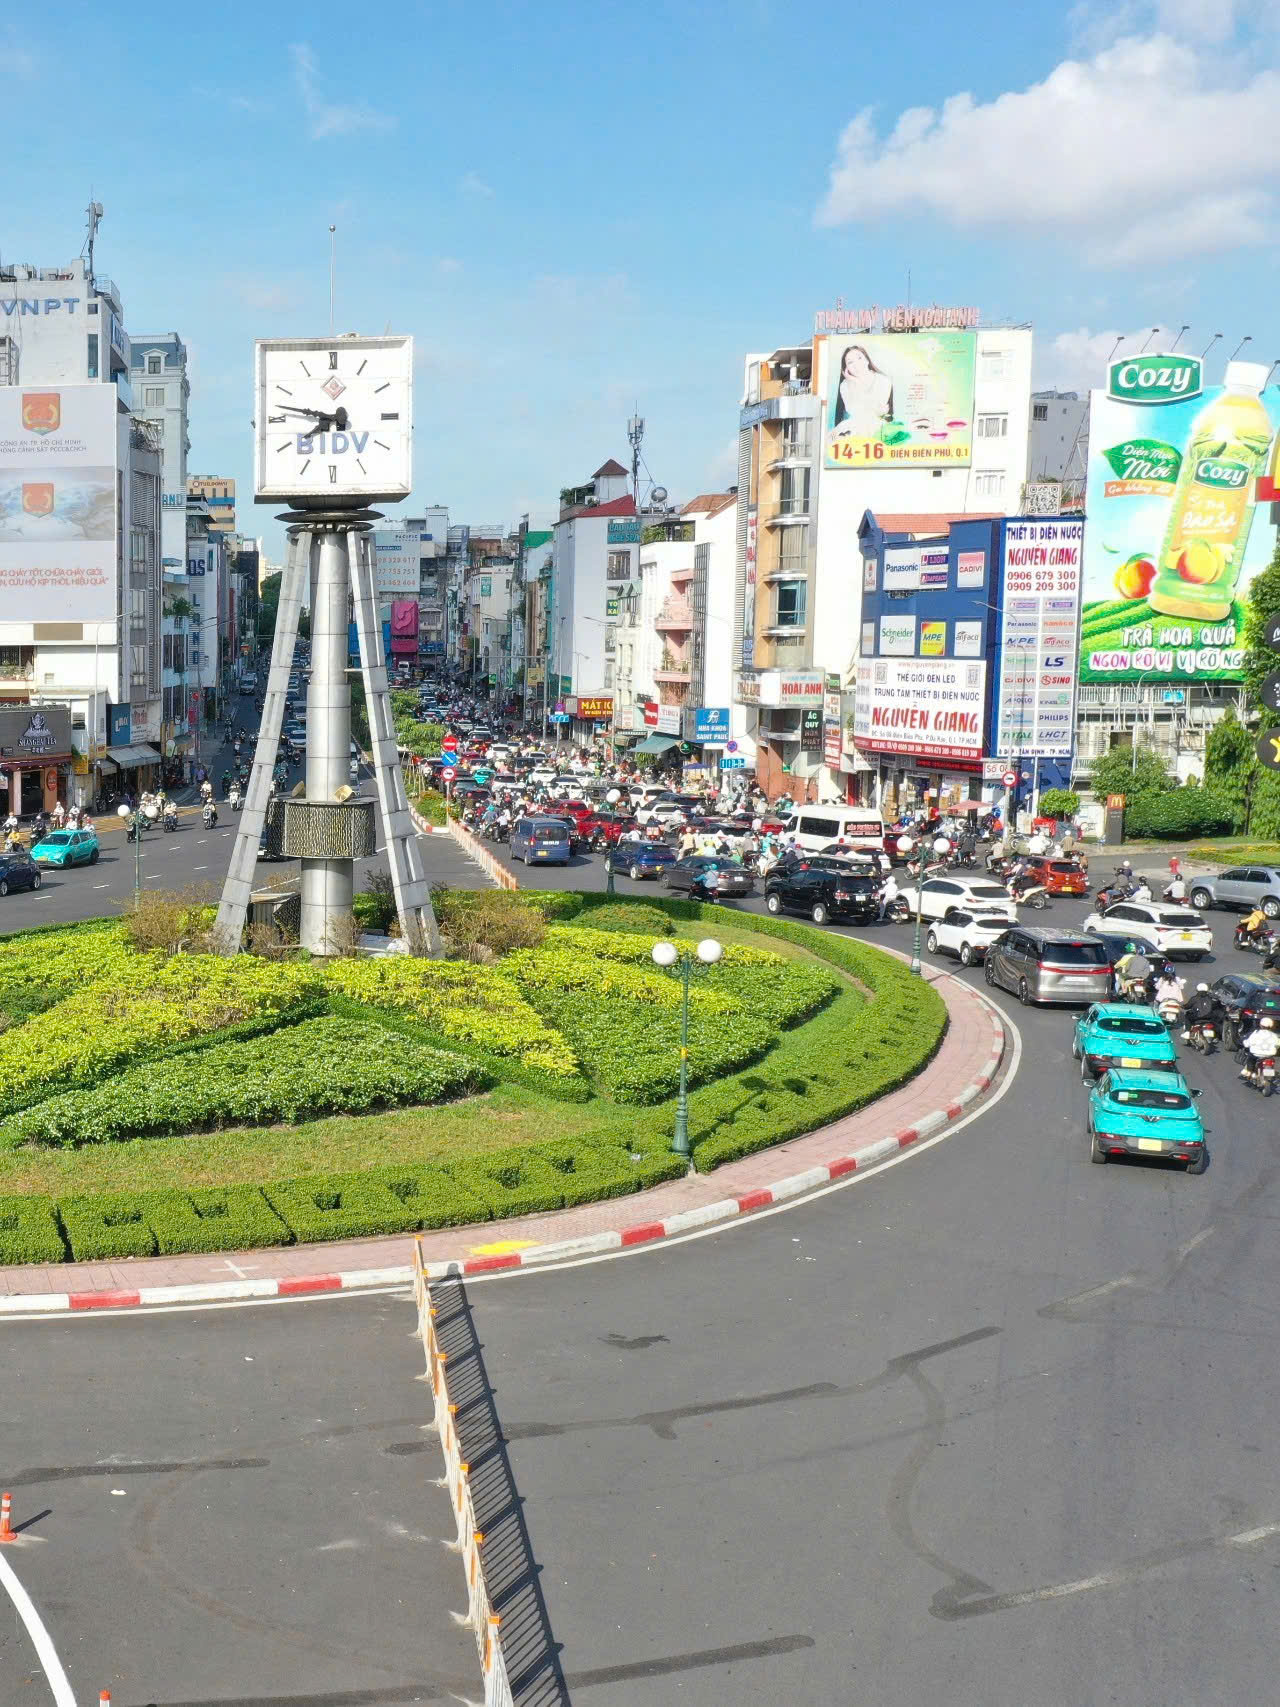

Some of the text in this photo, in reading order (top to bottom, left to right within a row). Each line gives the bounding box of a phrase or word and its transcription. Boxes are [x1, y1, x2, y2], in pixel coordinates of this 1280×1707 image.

[2, 298, 79, 316] VNPT
[1118, 362, 1193, 394] Cozy
[296, 431, 369, 455] BIDV
[832, 443, 884, 460] 14-16
[1197, 462, 1246, 486] Cozy
[1049, 547, 1078, 566] GIANG
[886, 562, 918, 573] Panasonic
[1007, 571, 1076, 580] 0906 679 300
[1007, 582, 1076, 591] 0909 209 300
[923, 633, 942, 641] MPE
[1122, 619, 1236, 647] TRÀ HOA QUẢ
[1044, 656, 1064, 667] LS
[1092, 652, 1129, 668] NGON
[1052, 676, 1071, 684] SINO
[804, 683, 822, 695] ANH
[933, 711, 978, 734] GIANG
